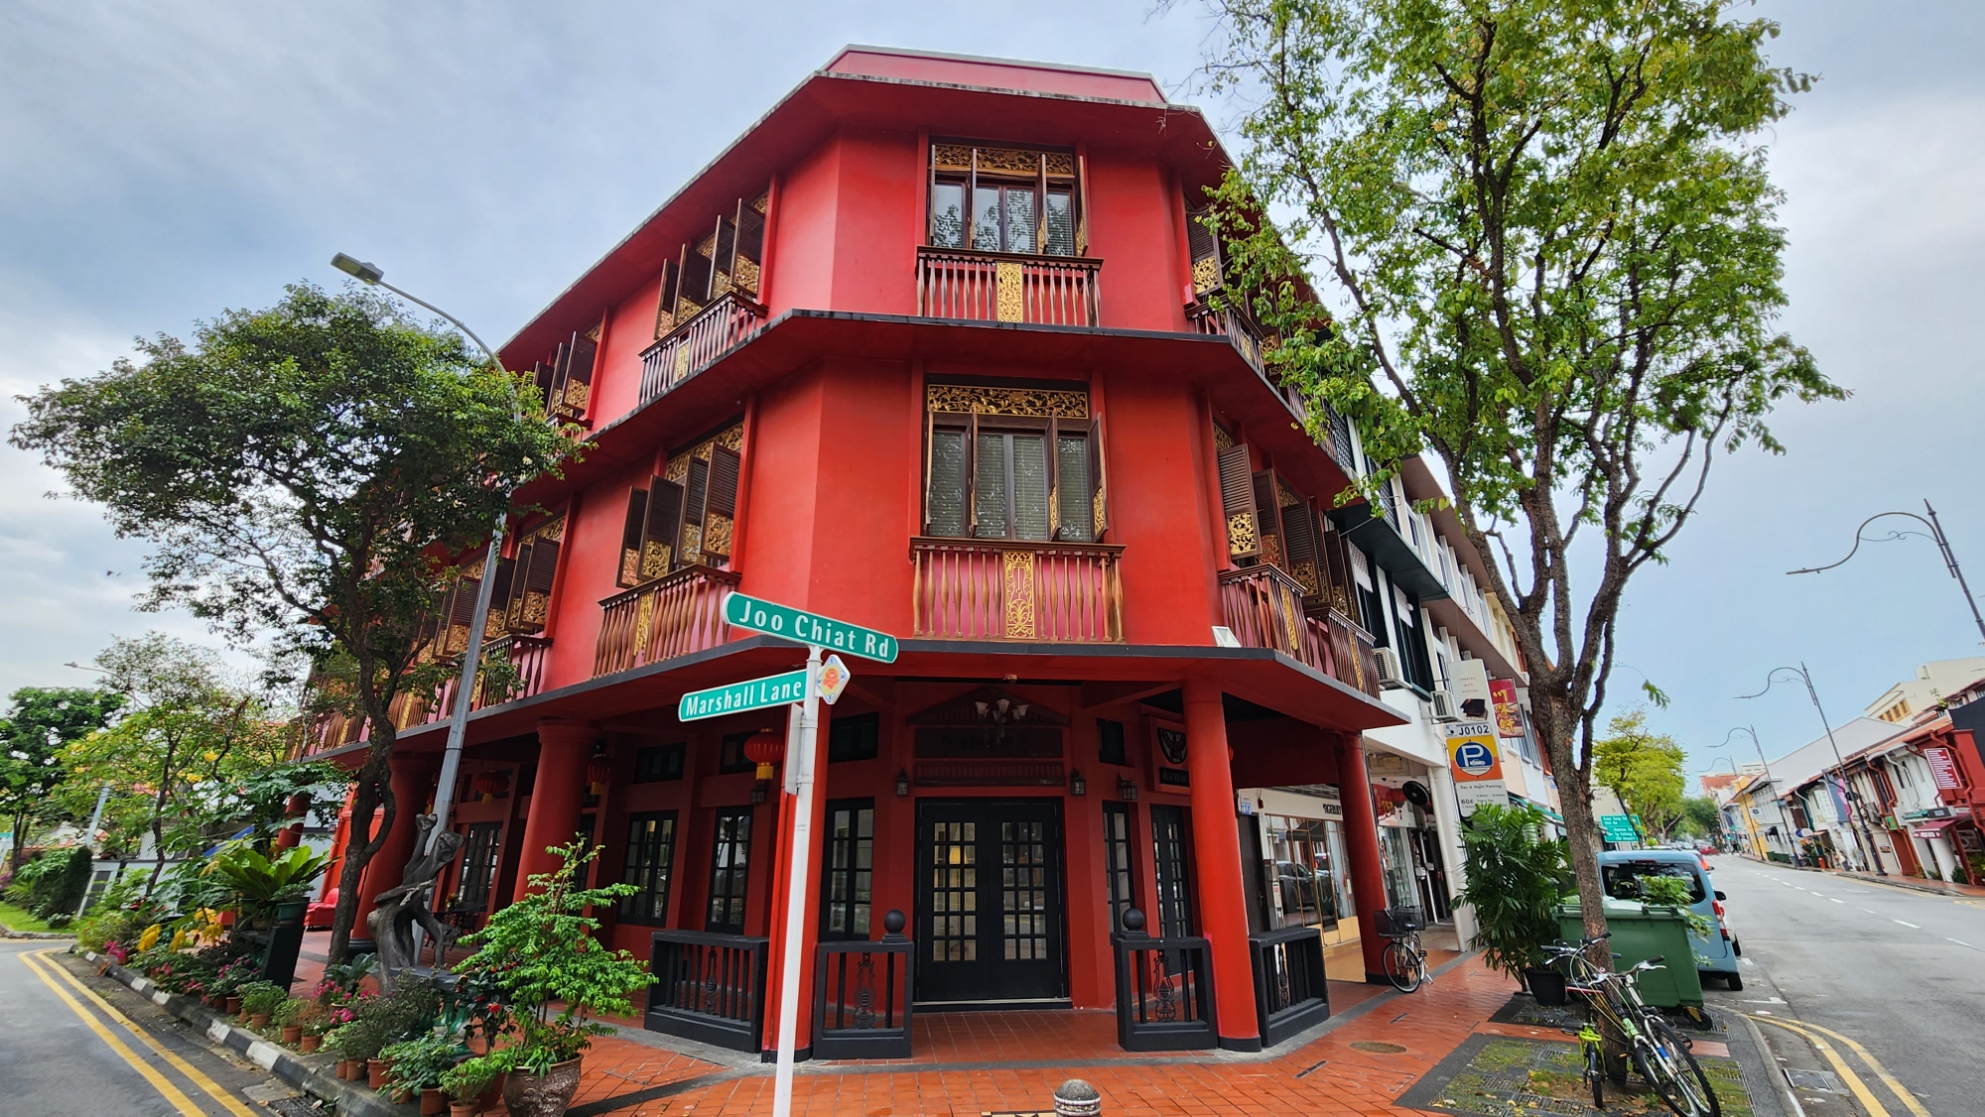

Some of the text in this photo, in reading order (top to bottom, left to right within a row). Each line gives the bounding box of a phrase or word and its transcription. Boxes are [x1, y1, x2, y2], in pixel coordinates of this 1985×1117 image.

[739, 600, 889, 658] Joo Chiat Rd
[686, 679, 802, 716] Marshall Lane
[1461, 744, 1485, 767] P
